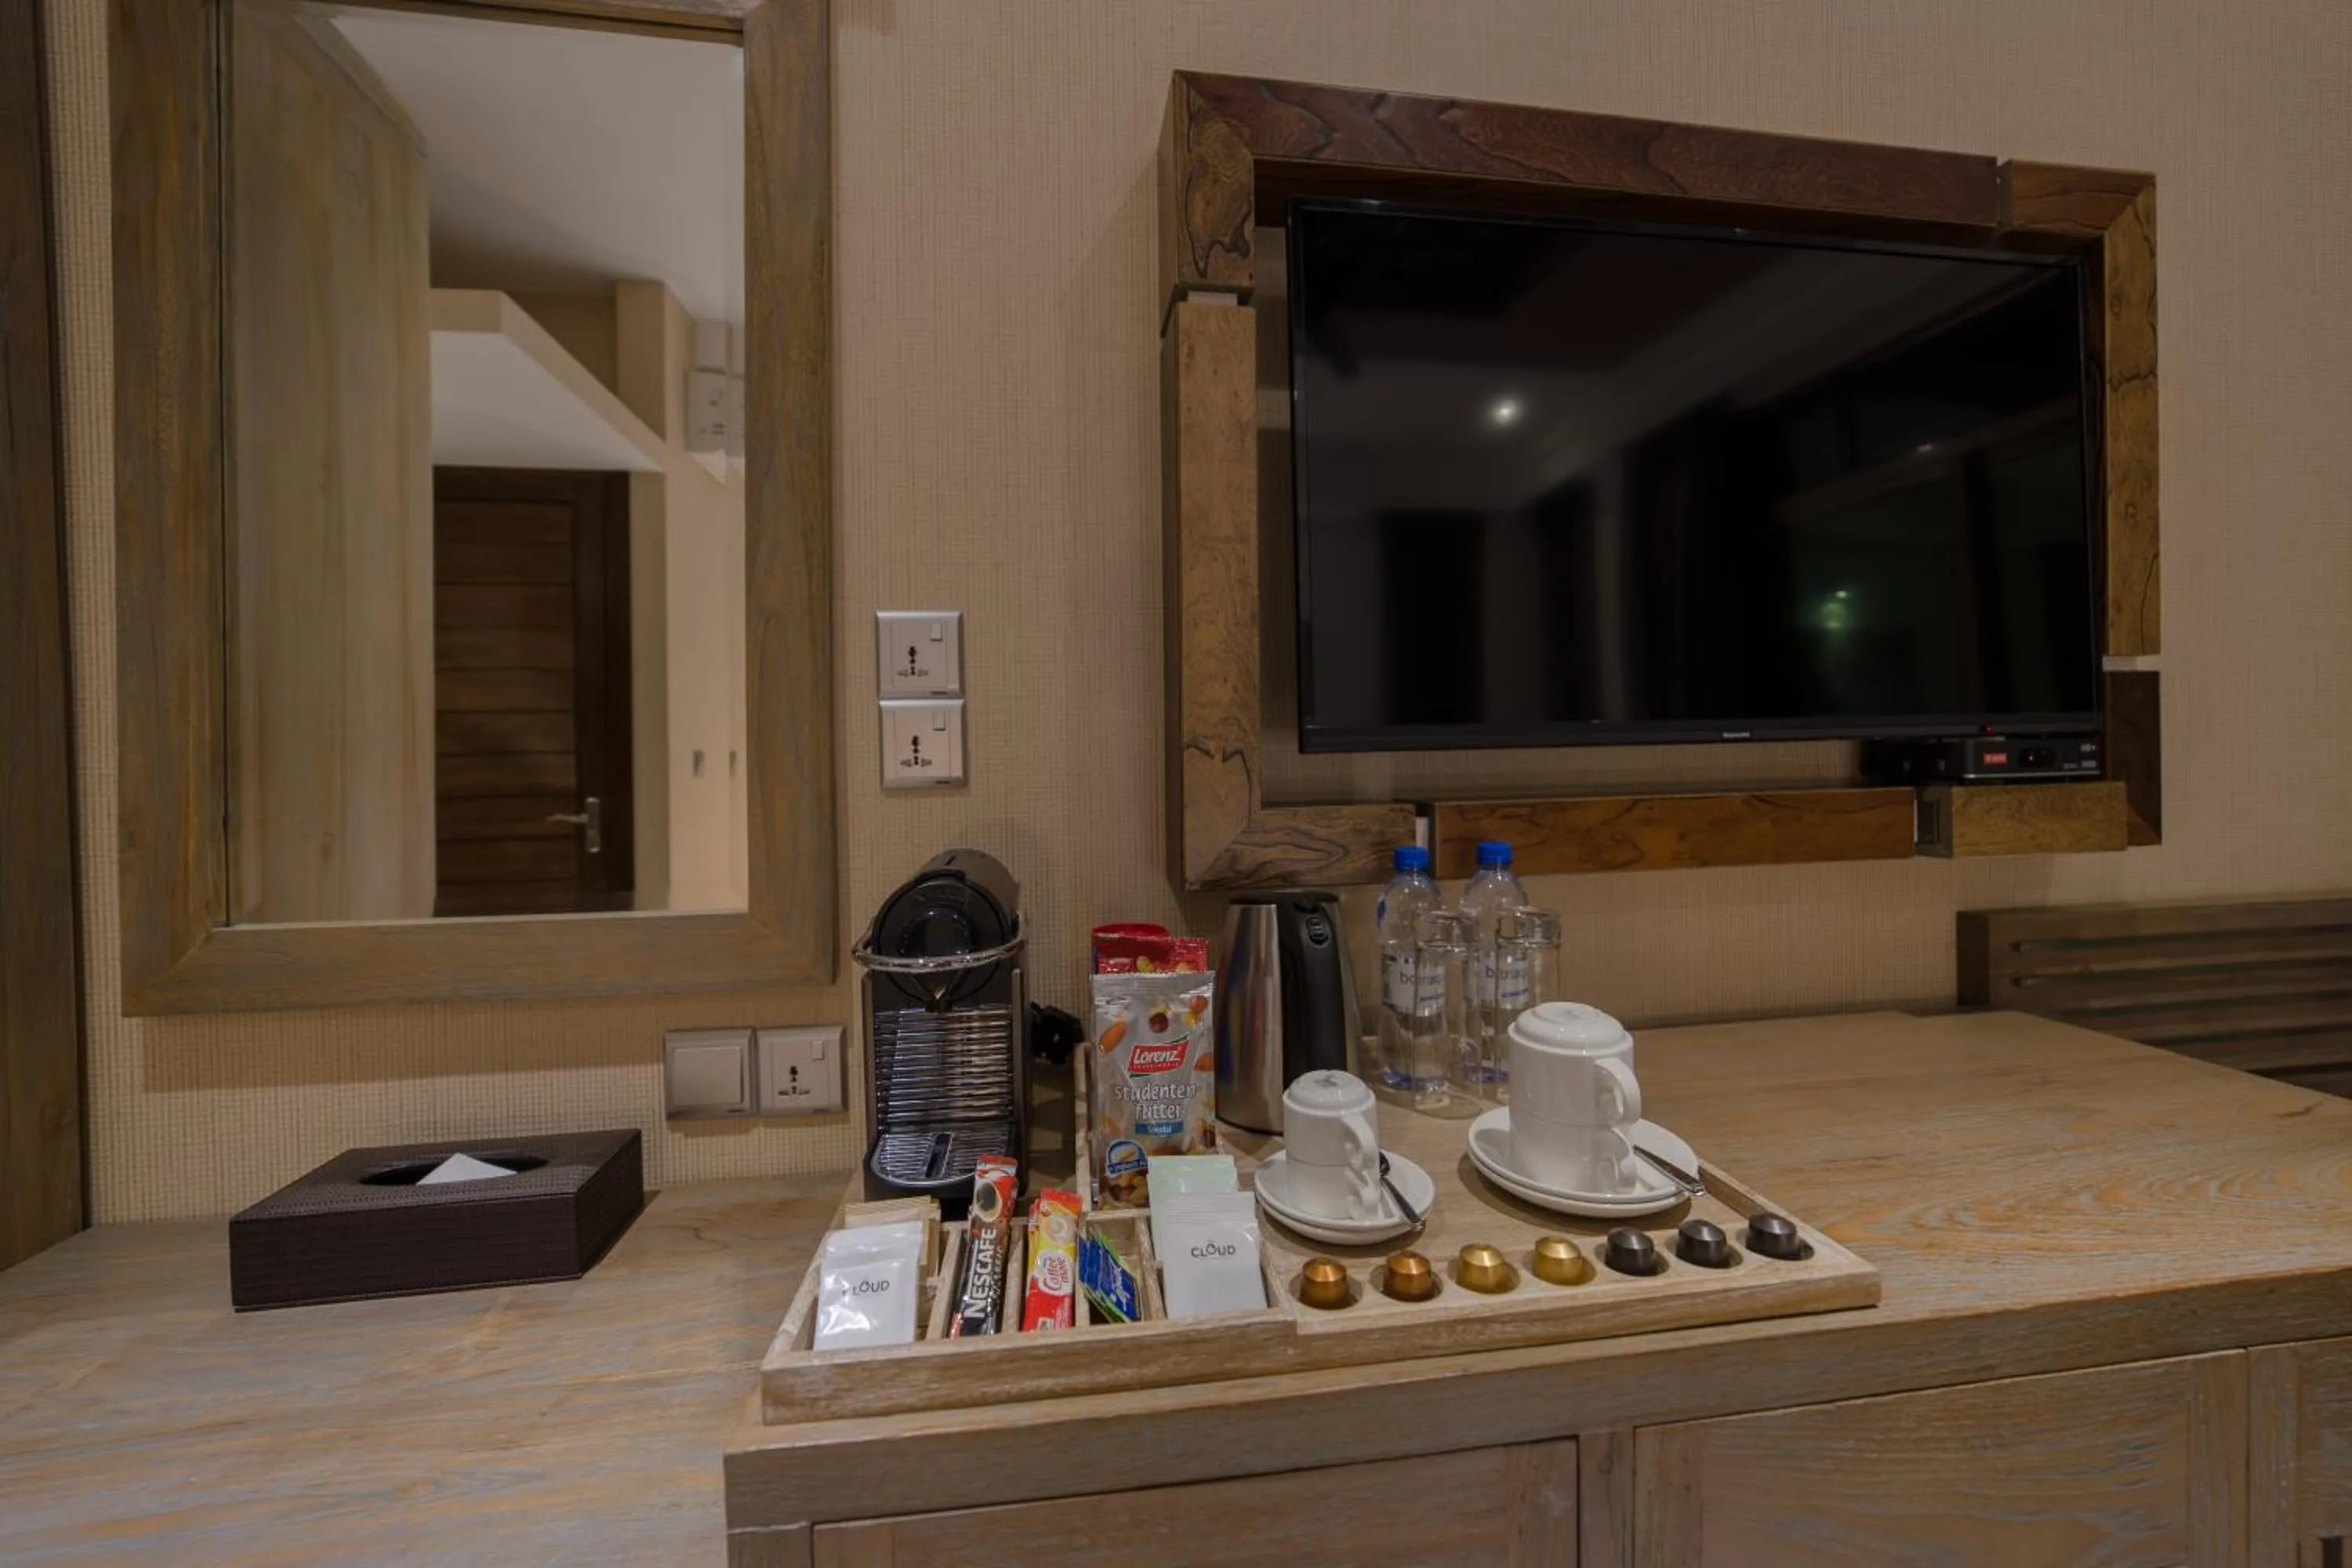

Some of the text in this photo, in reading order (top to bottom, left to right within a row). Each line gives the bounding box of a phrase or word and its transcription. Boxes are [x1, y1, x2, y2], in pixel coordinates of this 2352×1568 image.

[1133, 1047, 1180, 1065] Lorenz
[1191, 1241, 1236, 1258] CLOUD
[842, 1279, 890, 1297] LOUD
